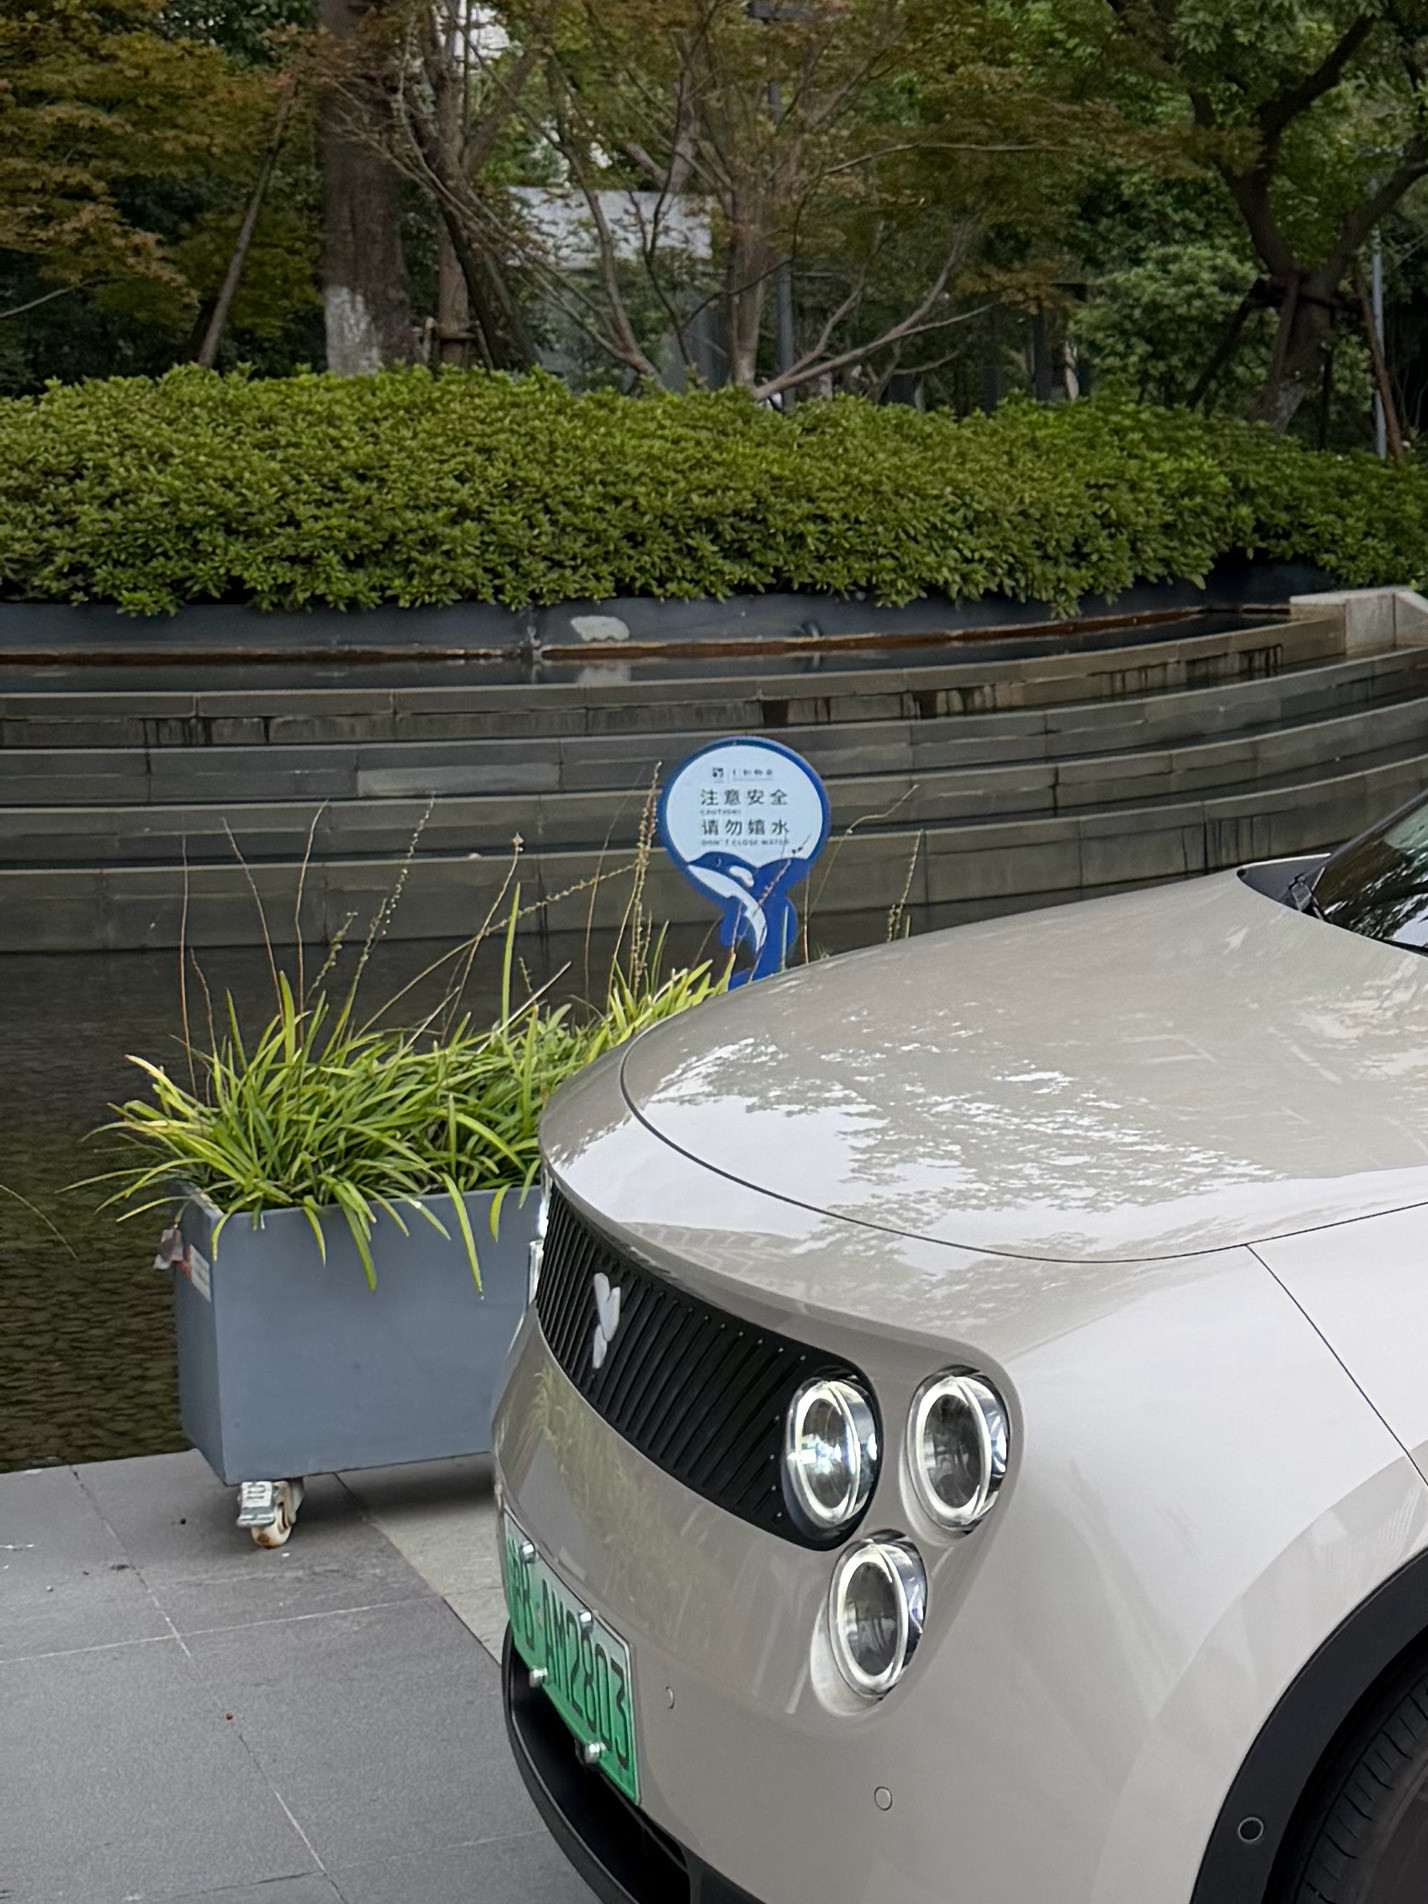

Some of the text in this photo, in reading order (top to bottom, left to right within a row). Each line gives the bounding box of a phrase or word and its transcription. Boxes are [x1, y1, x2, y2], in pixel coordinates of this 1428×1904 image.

[700, 788, 789, 806] 注意安全
[701, 818, 790, 836] 请勿嬉水
